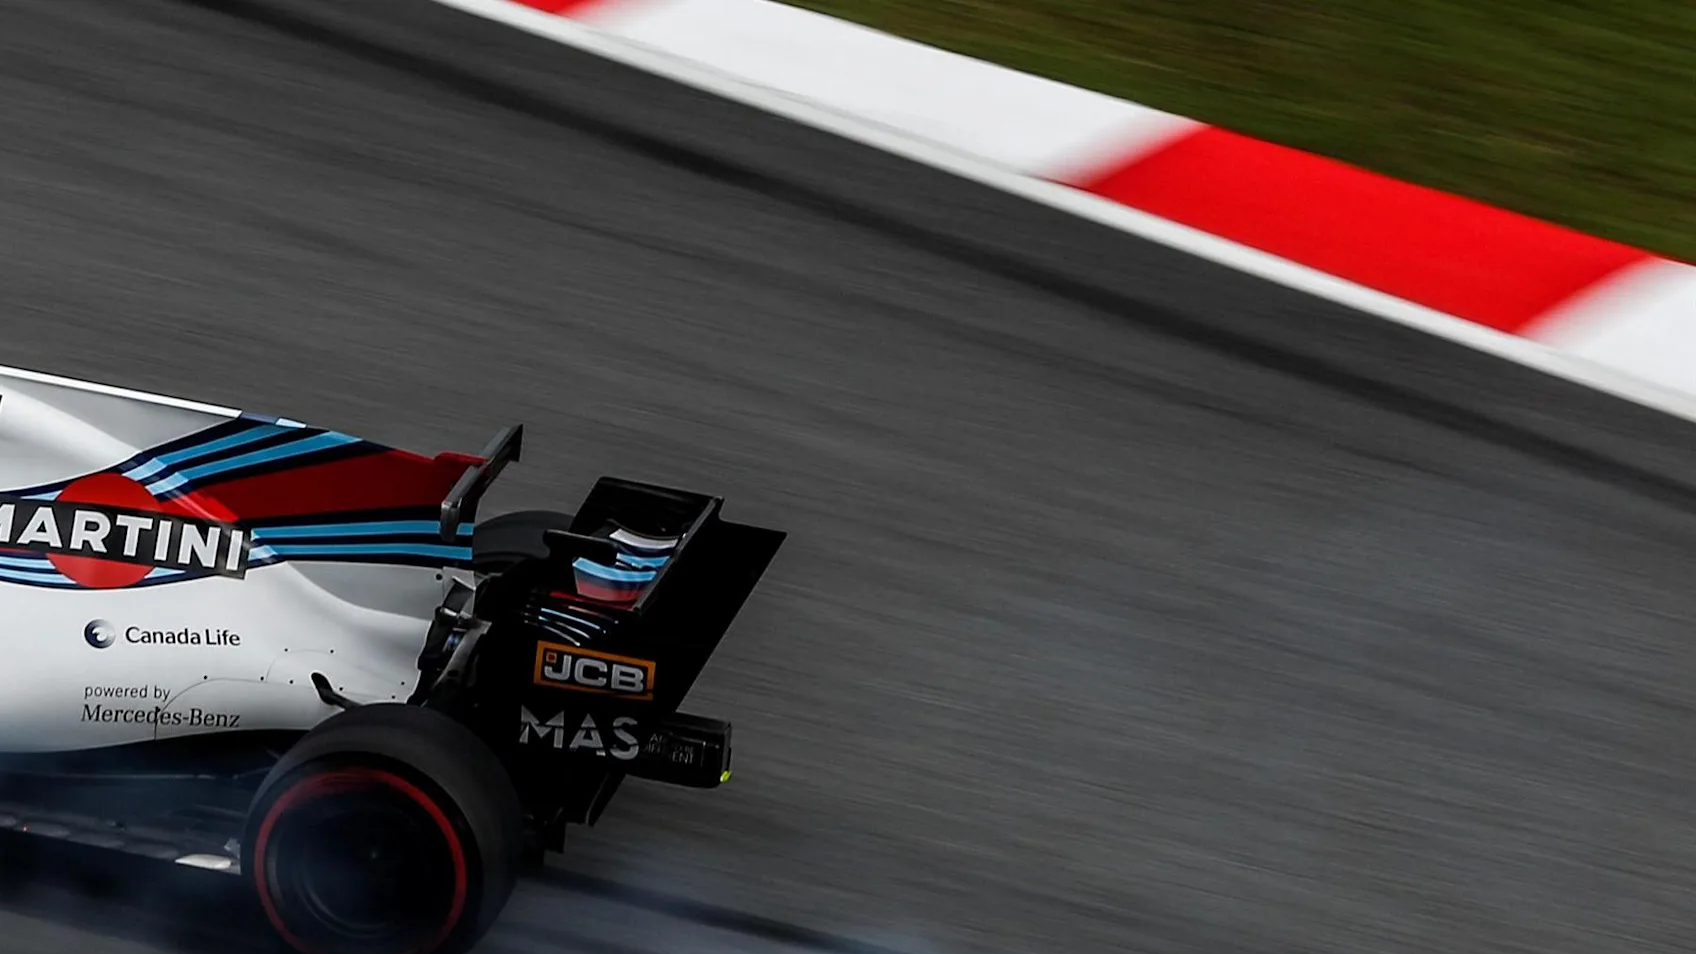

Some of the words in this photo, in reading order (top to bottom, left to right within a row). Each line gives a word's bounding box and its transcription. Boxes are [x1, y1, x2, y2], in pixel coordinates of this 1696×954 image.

[125, 626, 201, 645] Canada
[205, 628, 241, 647] Life
[544, 654, 644, 692] JCB
[84, 685, 149, 701] powered
[153, 684, 171, 706] by
[81, 704, 240, 729] Mercedes-Benz
[518, 703, 639, 760] MAS
